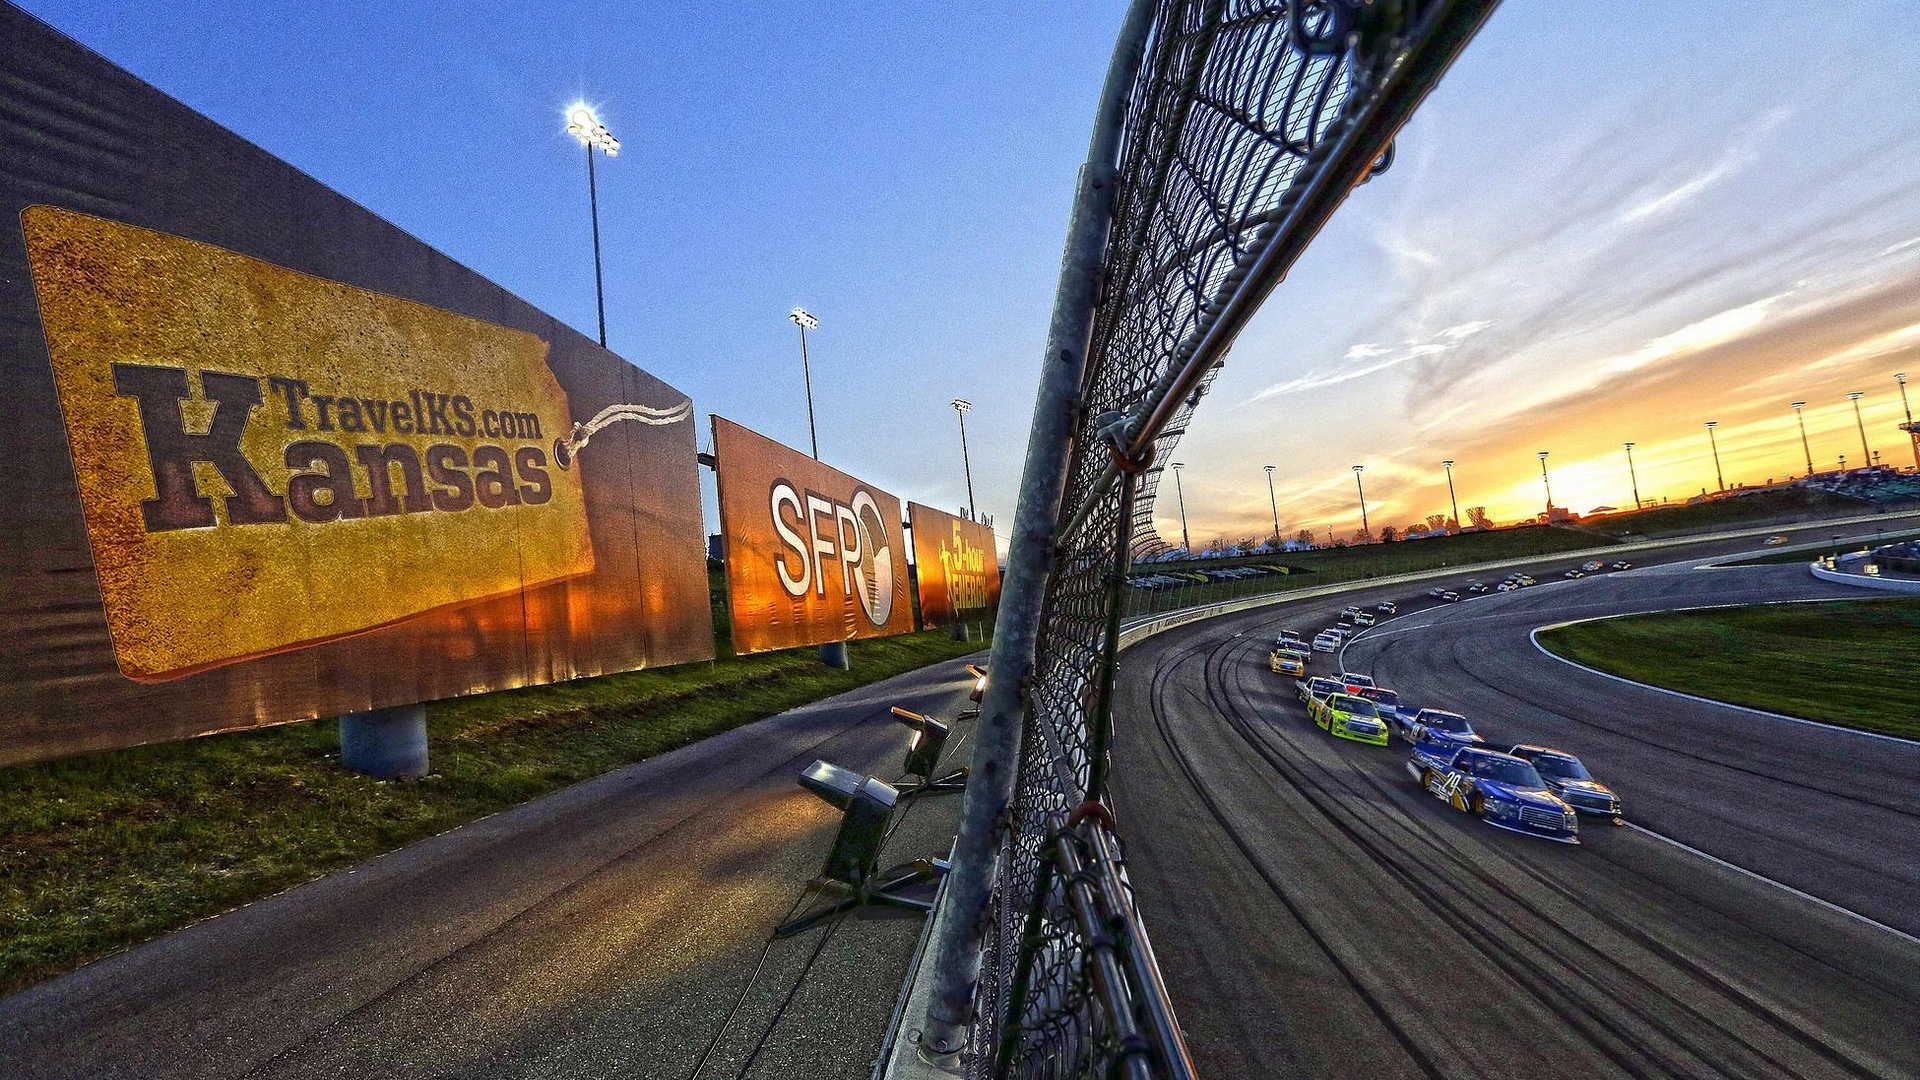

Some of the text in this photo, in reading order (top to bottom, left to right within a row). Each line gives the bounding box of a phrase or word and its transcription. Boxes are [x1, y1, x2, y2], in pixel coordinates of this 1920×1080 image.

[268, 375, 543, 440] TravelKS.com
[110, 362, 553, 533] Kansas
[952, 519, 985, 573] 5-hour
[952, 573, 986, 609] ENERGY
[1442, 771, 1461, 797] 29
